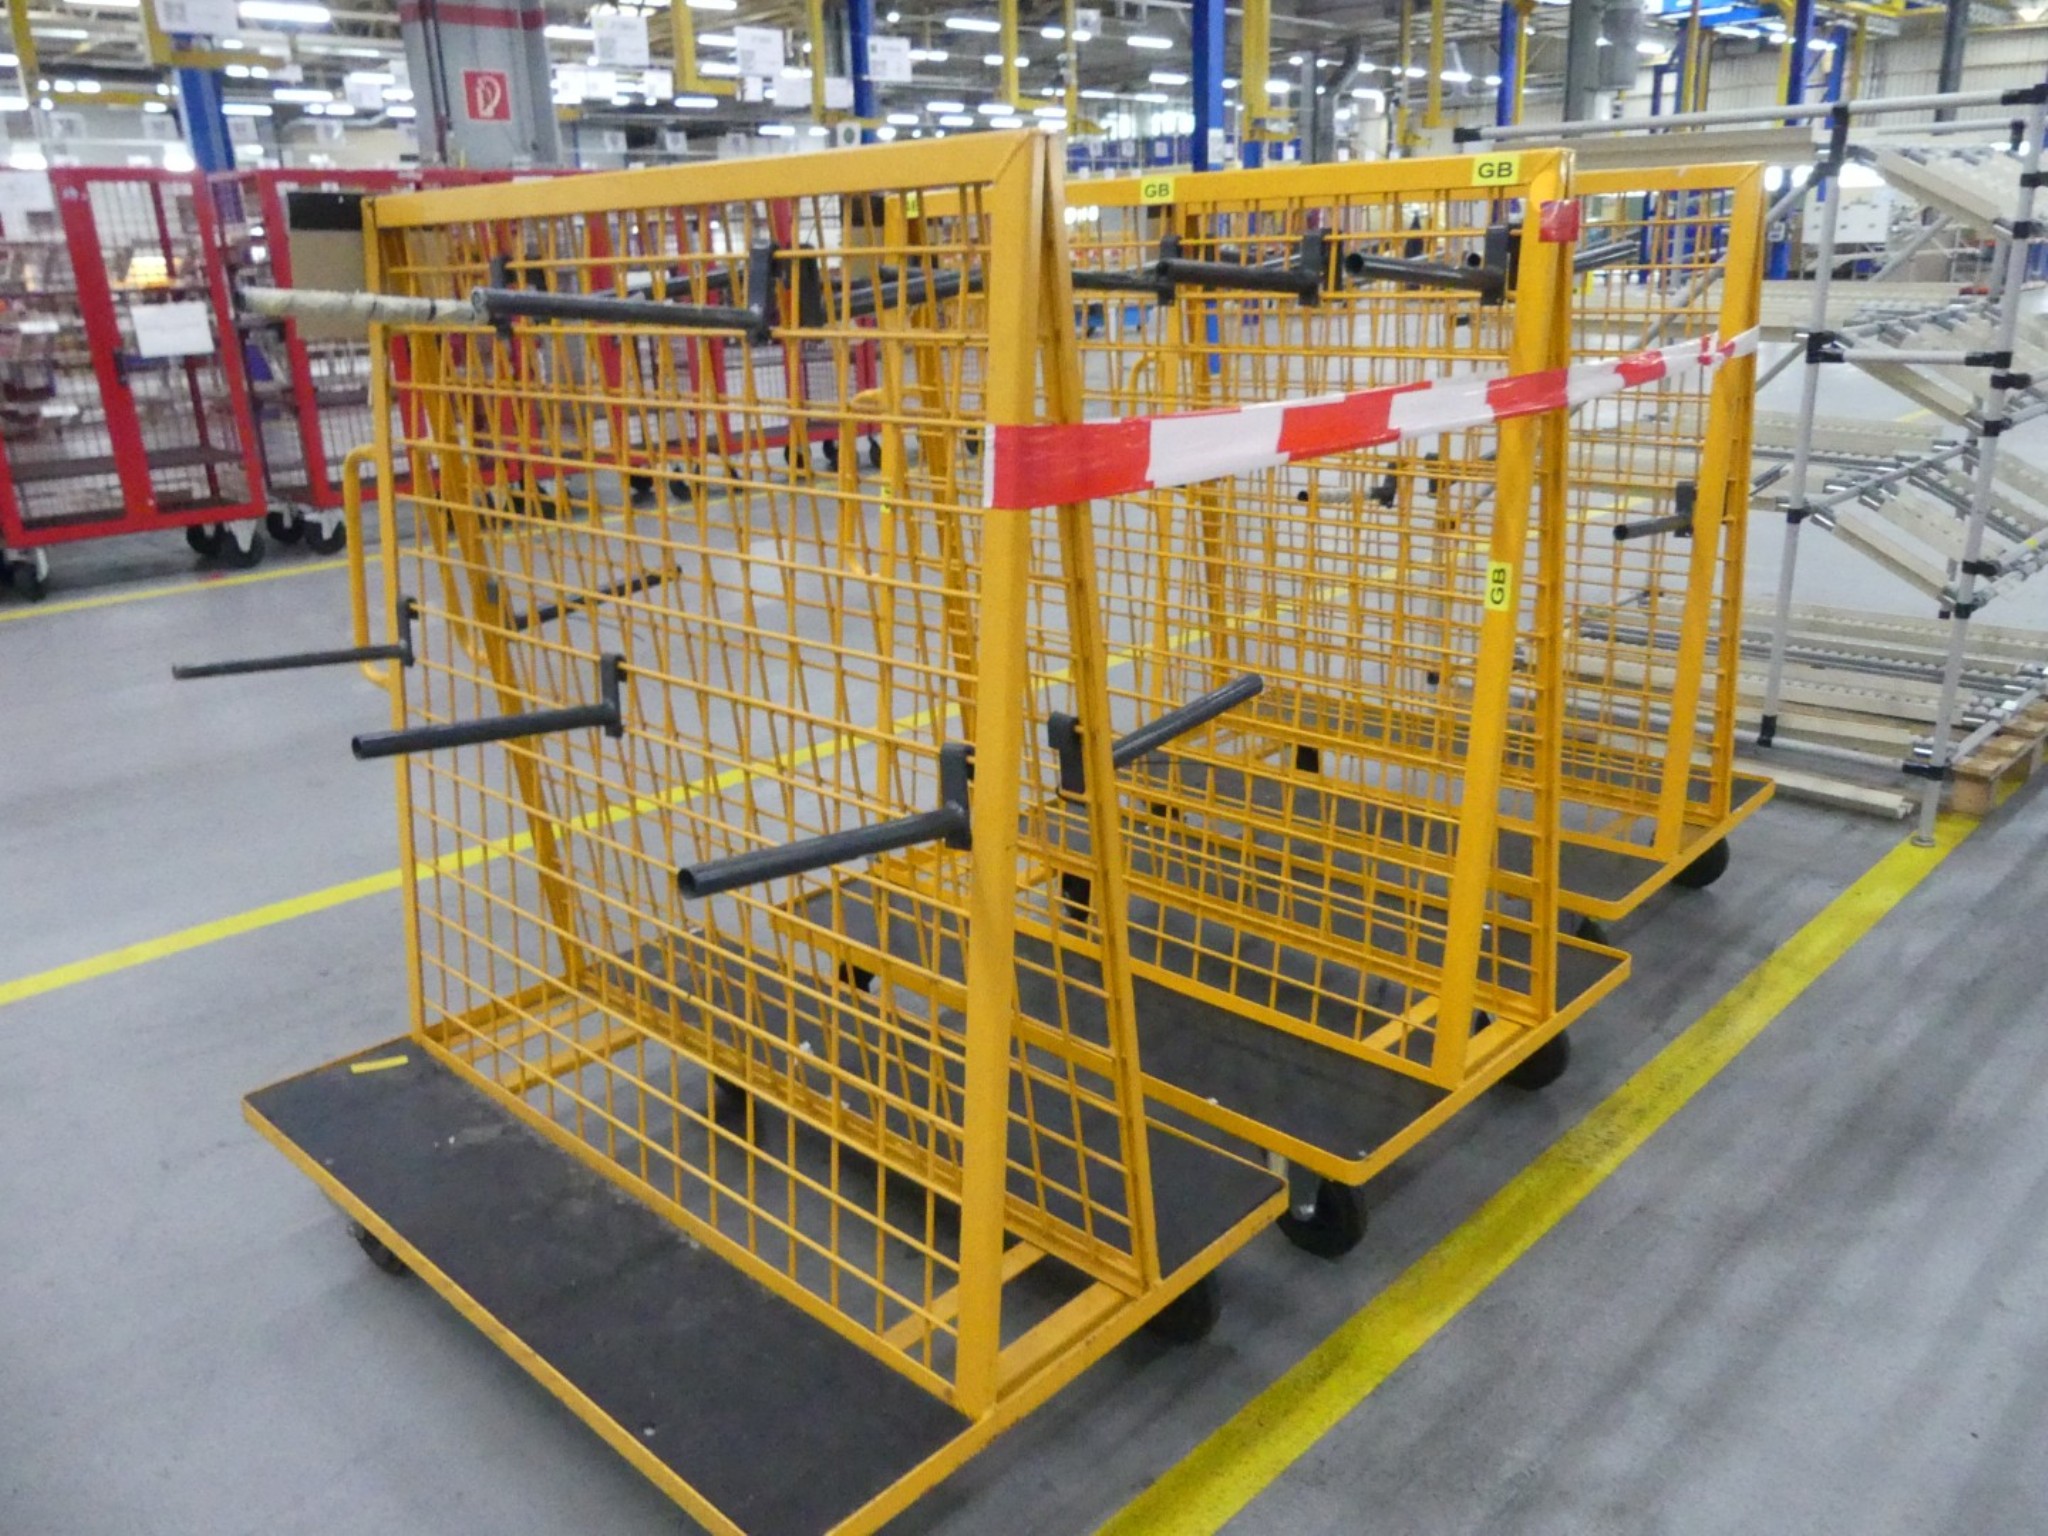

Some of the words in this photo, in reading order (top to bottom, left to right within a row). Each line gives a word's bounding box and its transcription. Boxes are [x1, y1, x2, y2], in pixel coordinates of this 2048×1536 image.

[1478, 161, 1513, 178] GB
[1144, 183, 1170, 198] GB
[1491, 568, 1505, 605] GB
